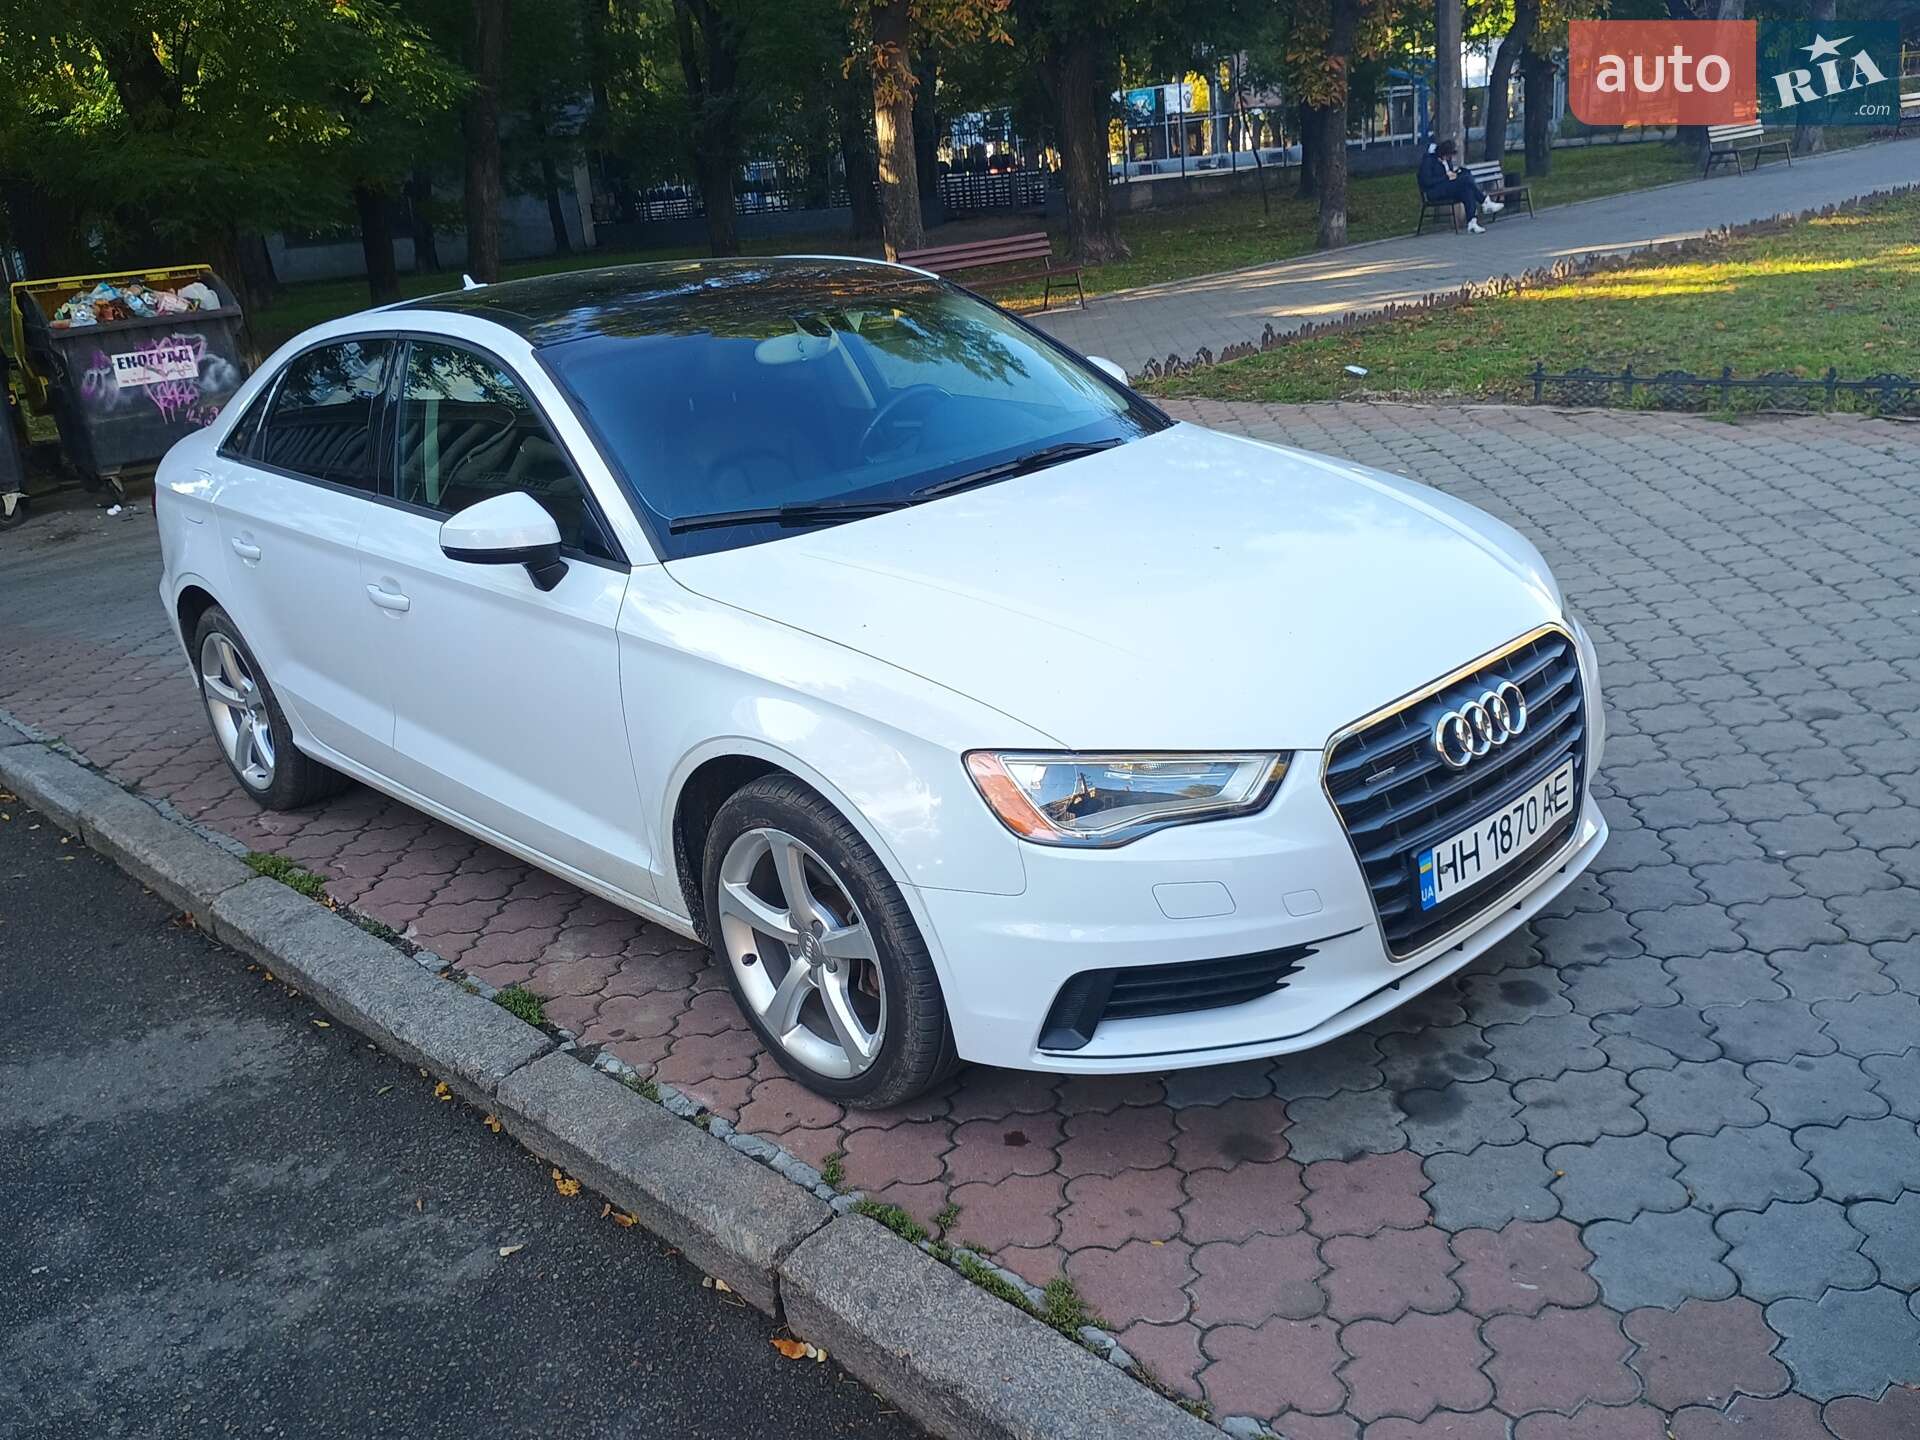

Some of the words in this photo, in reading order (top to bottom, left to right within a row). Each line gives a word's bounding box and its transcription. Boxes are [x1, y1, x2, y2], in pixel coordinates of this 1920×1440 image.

[1436, 832, 1480, 892] HH
[1487, 796, 1537, 860] 1870
[1543, 769, 1568, 825] AE
[1421, 888, 1434, 901] UA
